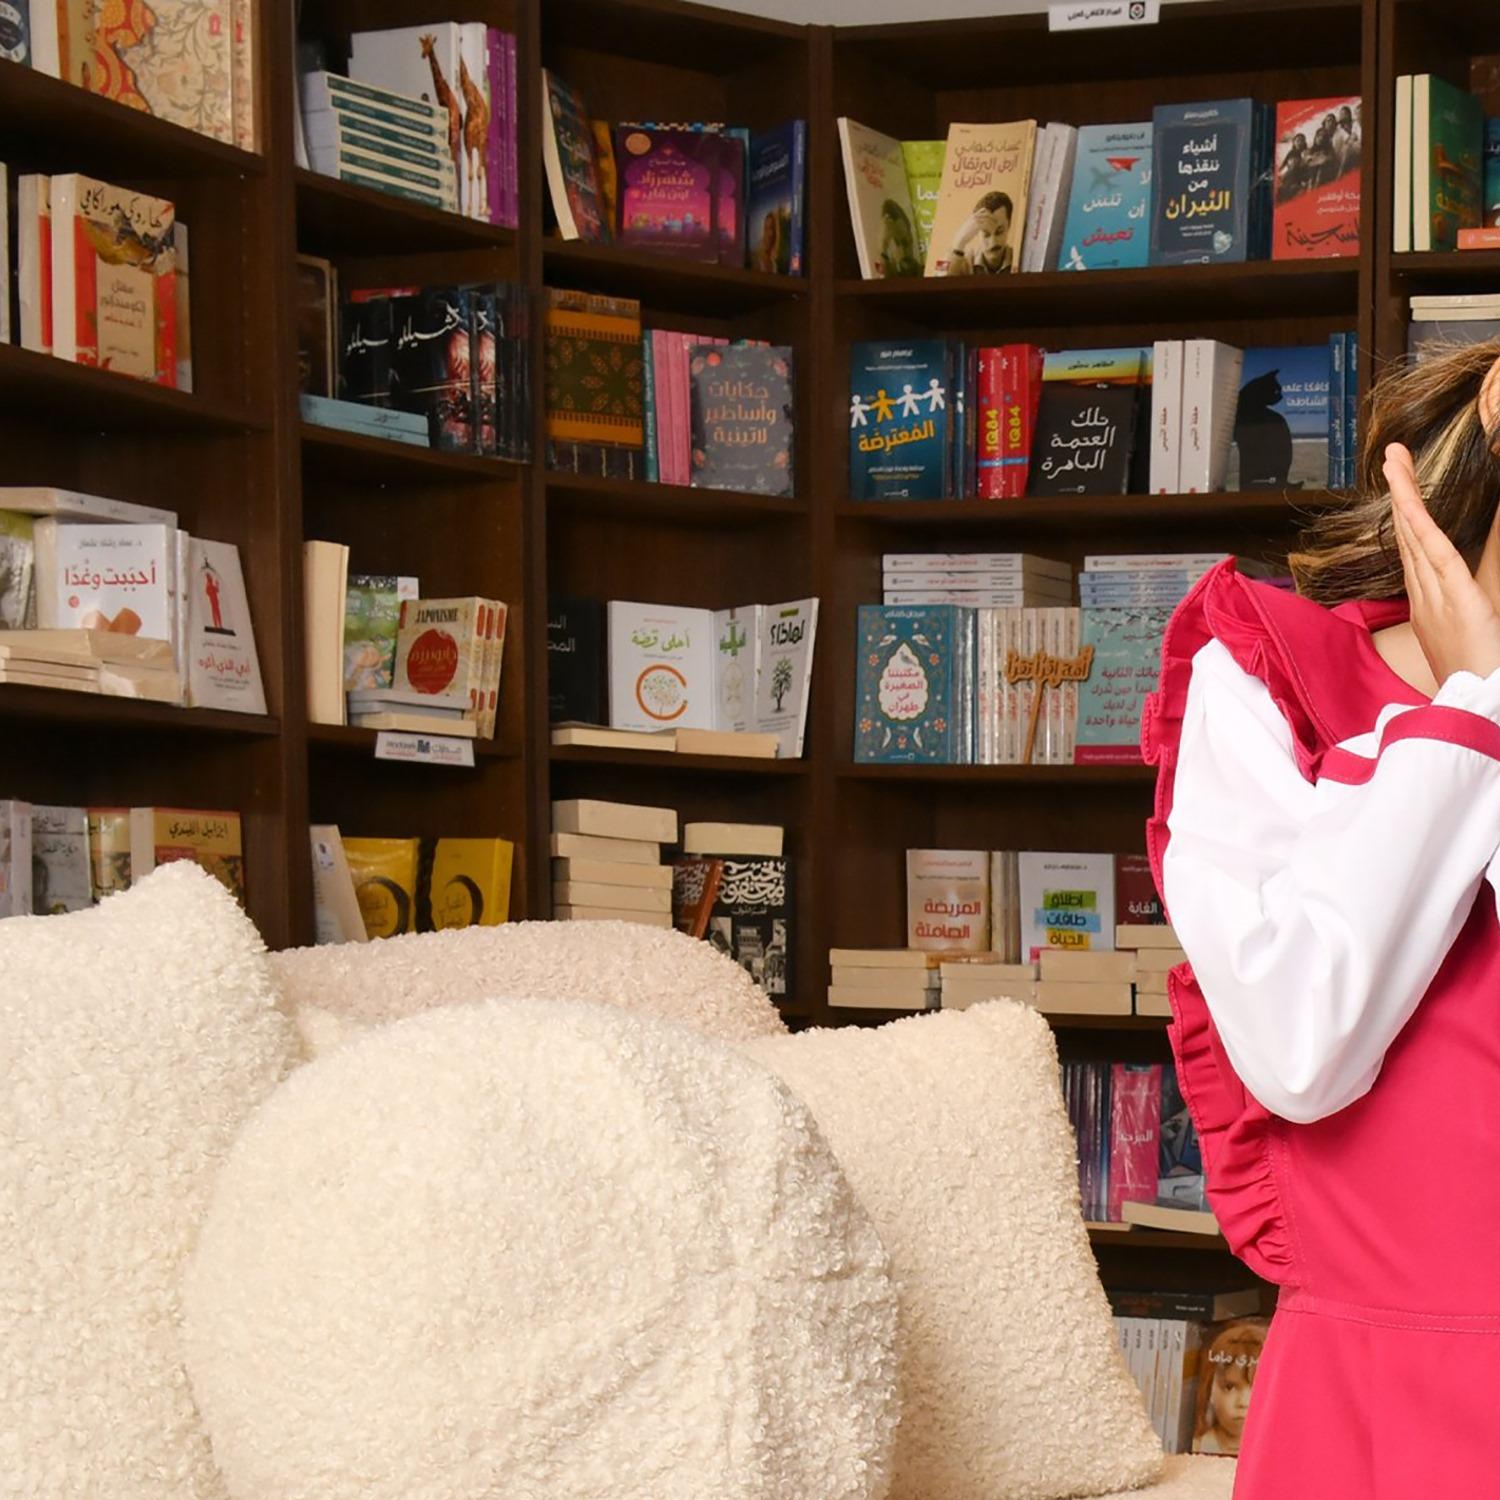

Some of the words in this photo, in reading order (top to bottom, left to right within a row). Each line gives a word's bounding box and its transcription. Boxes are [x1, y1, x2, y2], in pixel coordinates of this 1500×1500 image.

[1182, 134, 1217, 156] أشياء
[1178, 159, 1220, 175] ننقذها
[955, 172, 993, 189] الحزين
[1188, 178, 1208, 192] من
[1166, 190, 1231, 219] النيران
[708, 380, 768, 399] حكايات
[1071, 406, 1109, 427] تلك
[986, 409, 998, 453] 1Q84
[1009, 406, 1021, 449] 1Q84
[1050, 425, 1116, 449] العتمة
[1041, 450, 1106, 478] الباهرة
[888, 702, 919, 714] طهران
[1050, 893, 1084, 907] إطلاق
[924, 901, 981, 917] المريضة
[1047, 913, 1087, 927] طاقات
[916, 923, 971, 939] الصامتة
[1050, 933, 1085, 947] الحياة
